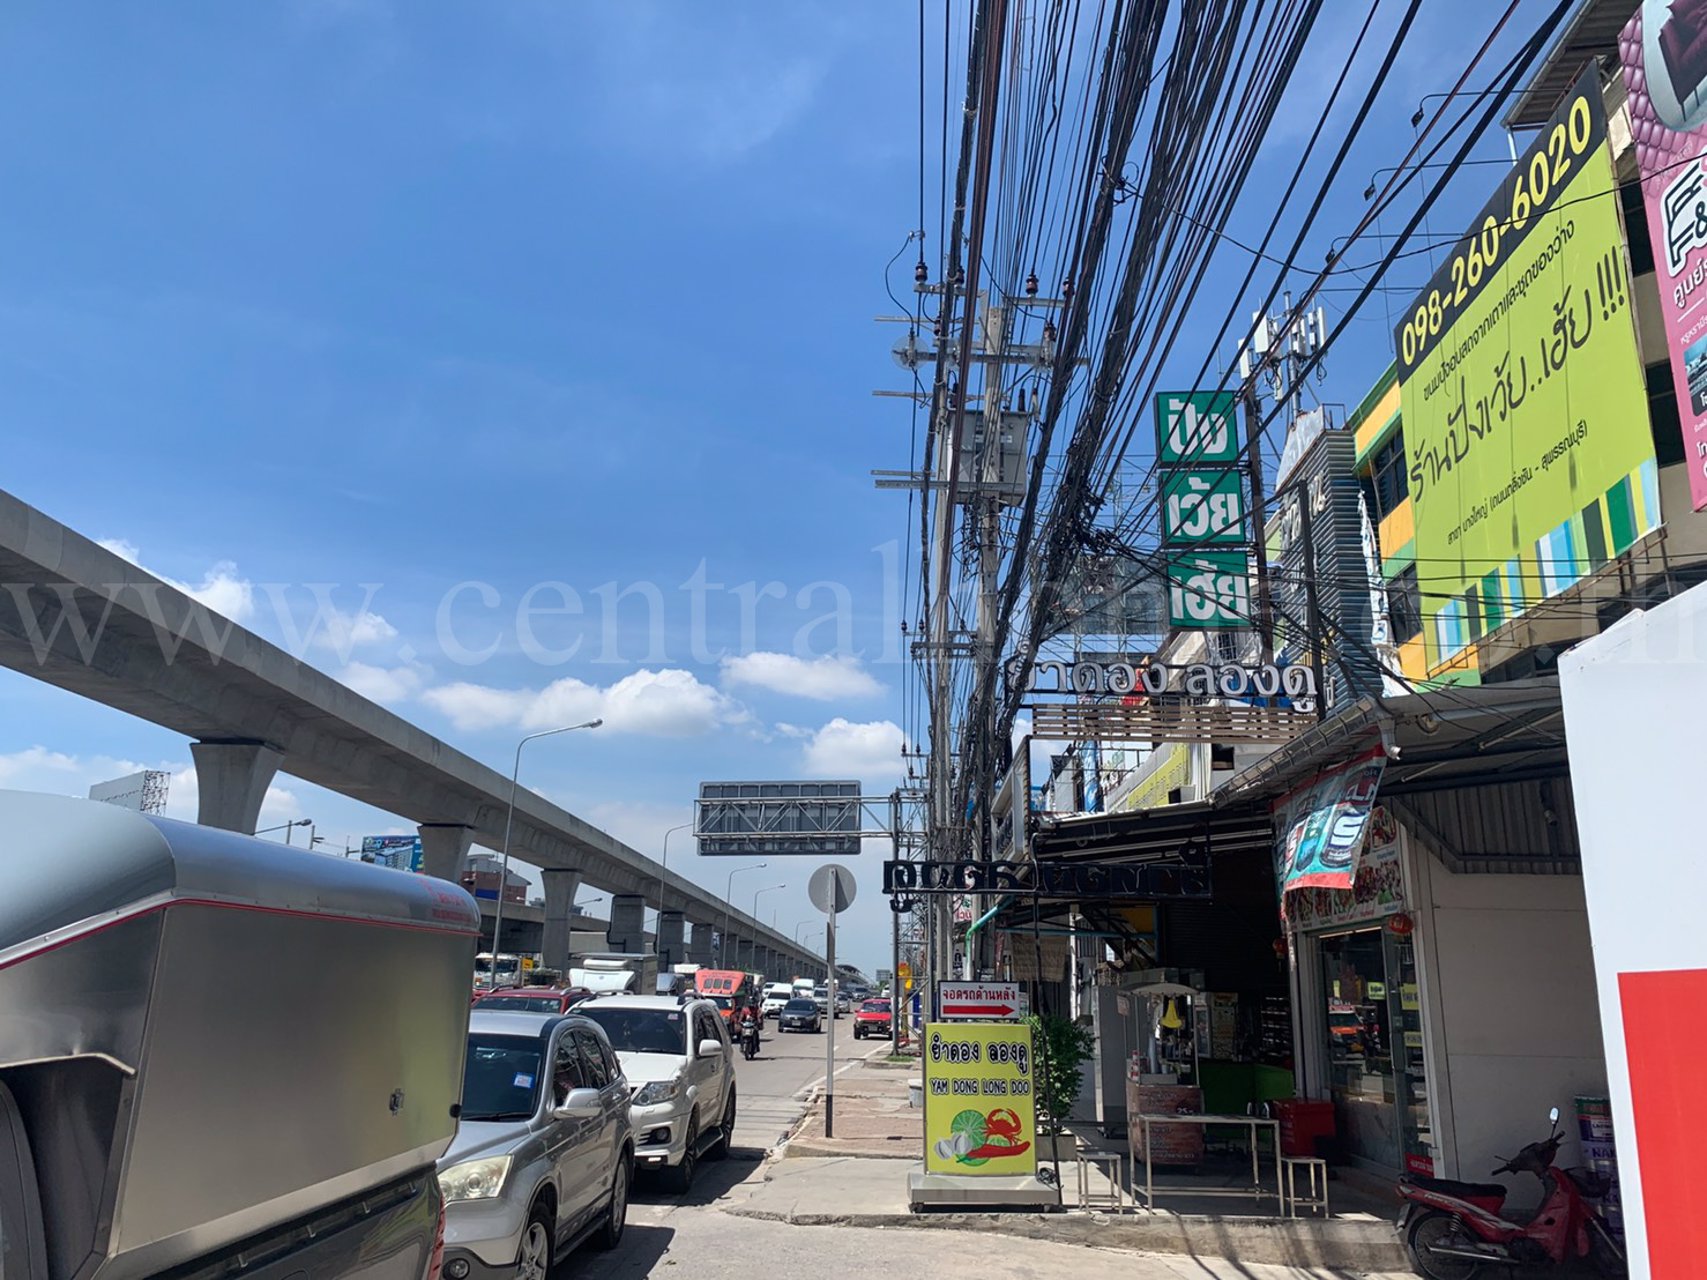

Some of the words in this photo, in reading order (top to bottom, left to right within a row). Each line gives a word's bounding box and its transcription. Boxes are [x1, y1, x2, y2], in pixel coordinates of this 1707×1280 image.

[1402, 95, 1592, 366] 098-260-6020
[1167, 397, 1228, 455] ปัง
[1168, 476, 1241, 537] เว้ย
[1171, 558, 1248, 621] เฮ้ย
[1185, 661, 1318, 714] ลองดู
[942, 984, 1016, 1001] จอดรถด้านหลัง
[931, 1032, 981, 1064] ยำดอง
[987, 1042, 1030, 1077] ลองดู
[931, 1077, 950, 1096] YAM
[952, 1077, 979, 1096] DONG
[981, 1077, 1008, 1096] LONG
[1010, 1077, 1031, 1096] DOO
